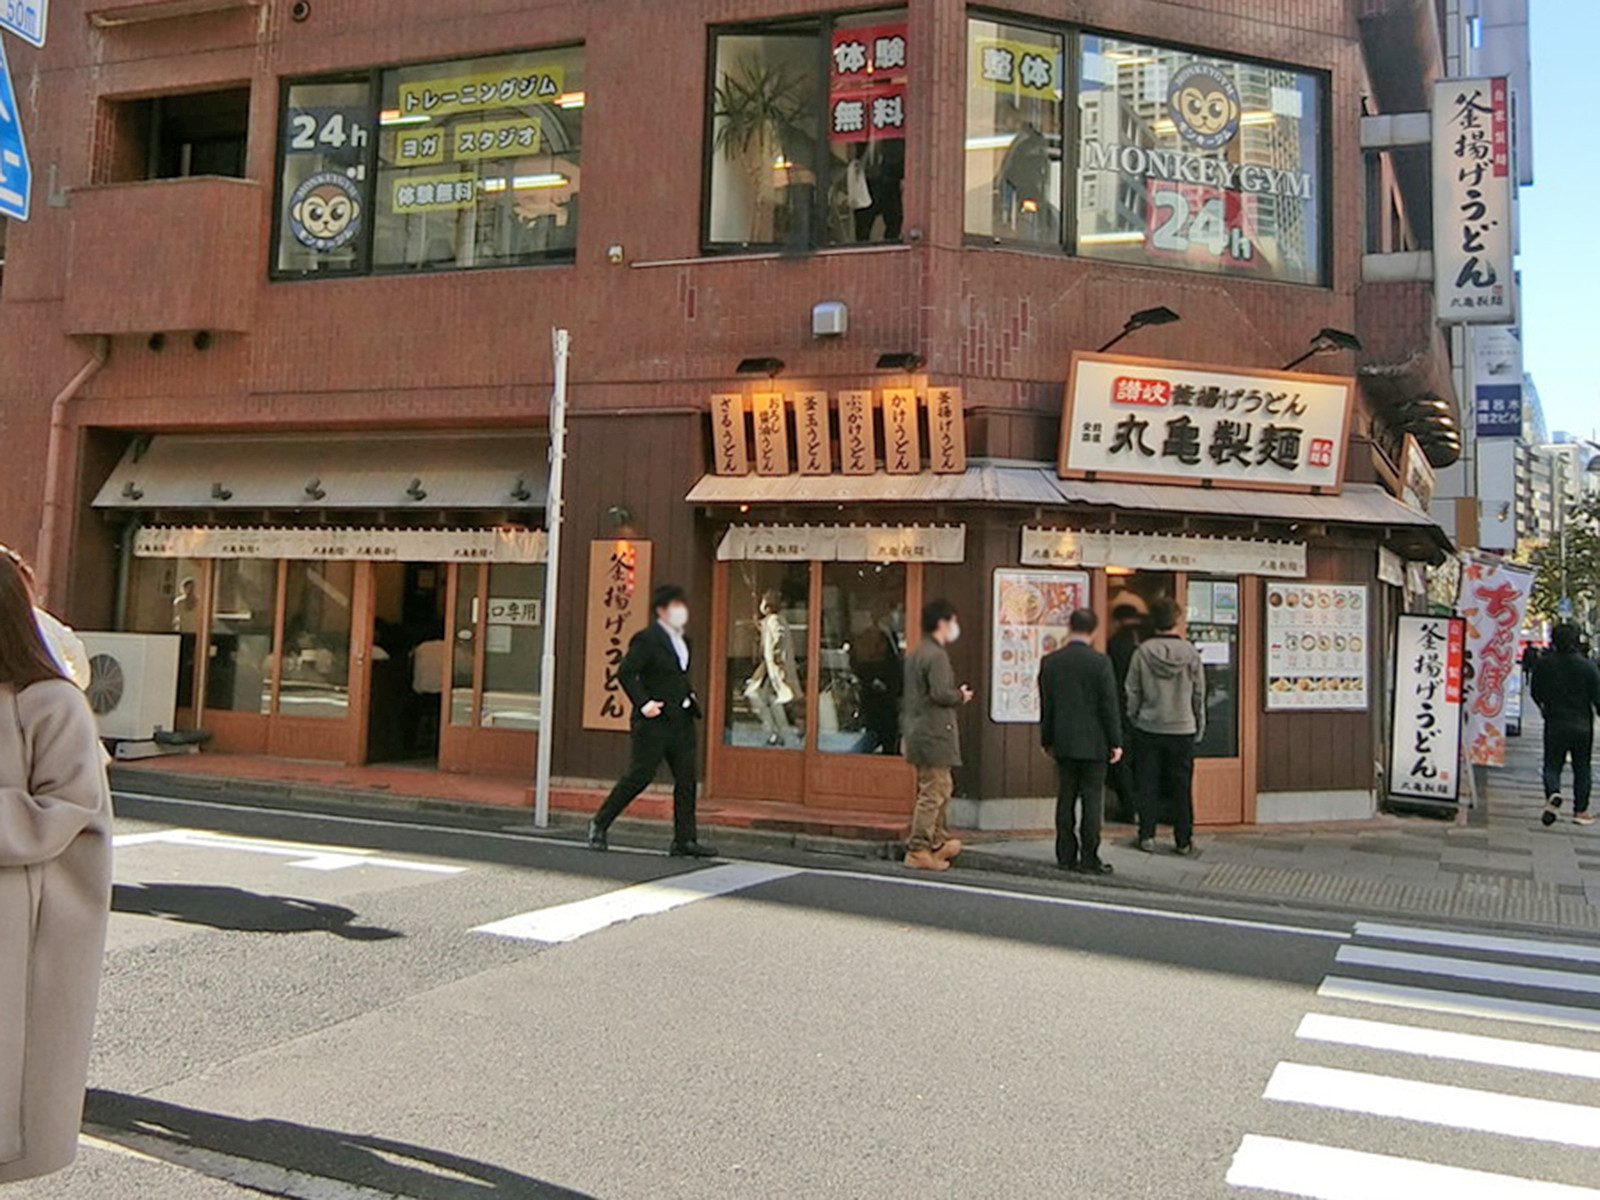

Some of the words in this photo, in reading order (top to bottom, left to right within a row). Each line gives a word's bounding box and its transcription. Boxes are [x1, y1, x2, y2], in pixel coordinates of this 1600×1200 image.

[834, 36, 906, 74] 体験
[981, 46, 1053, 89] 整体
[405, 74, 558, 112] トレーニングジム
[834, 96, 904, 132] 無料
[291, 112, 369, 150] 24h
[402, 134, 439, 158] ヨガ
[458, 125, 536, 152] スタジオ
[397, 179, 474, 207] 体験無料
[1087, 141, 1312, 199] MONKEYGYM
[1446, 90, 1499, 289] 釜揚げうどん
[1151, 189, 1252, 261] 24h
[1114, 378, 1169, 404] 讃岐
[1171, 383, 1308, 418] 釜揚げうどん
[803, 395, 821, 471] 釜玉うどん
[891, 393, 910, 471] かけうどん
[937, 390, 956, 470] 釜揚げうどん
[1108, 413, 1304, 472] 丸亀製麺
[1473, 582, 1522, 718] ちゃんぽん
[1410, 622, 1447, 779] 釜揚げうどん
